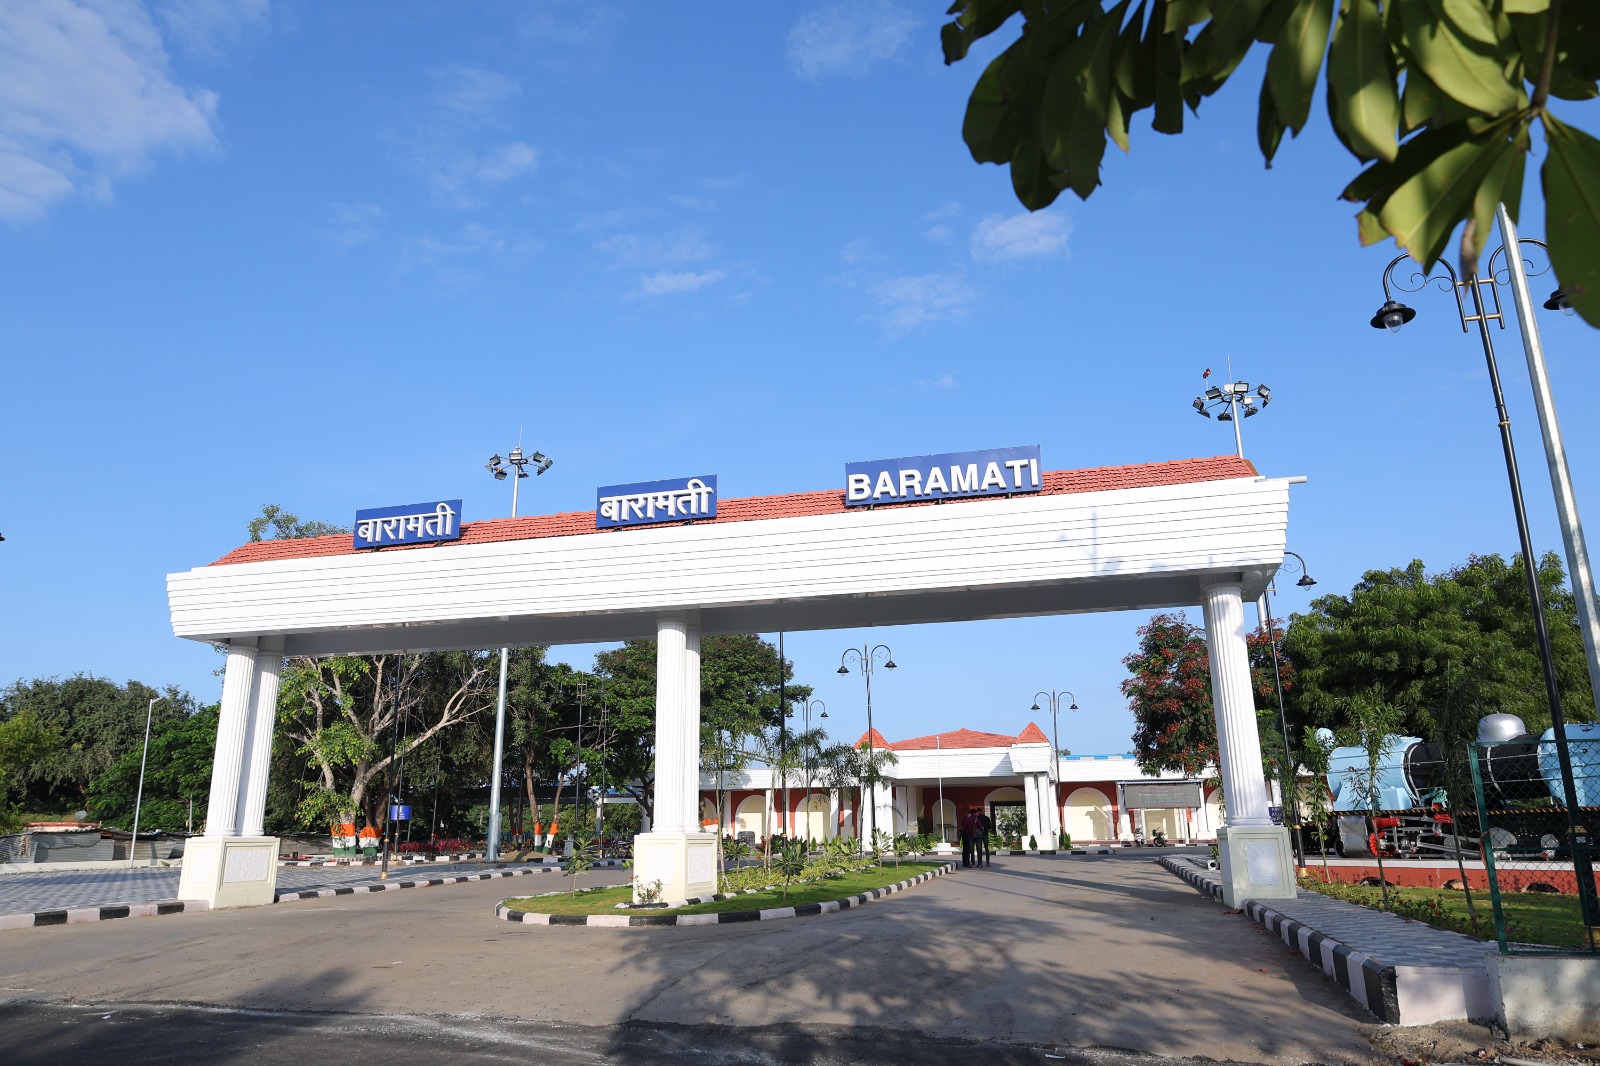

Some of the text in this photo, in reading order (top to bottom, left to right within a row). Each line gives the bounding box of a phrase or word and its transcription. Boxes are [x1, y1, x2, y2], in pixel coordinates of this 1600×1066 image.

[600, 478, 714, 522] बारामती
[848, 459, 1040, 501] BARAMATI
[357, 502, 456, 543] बारामती
